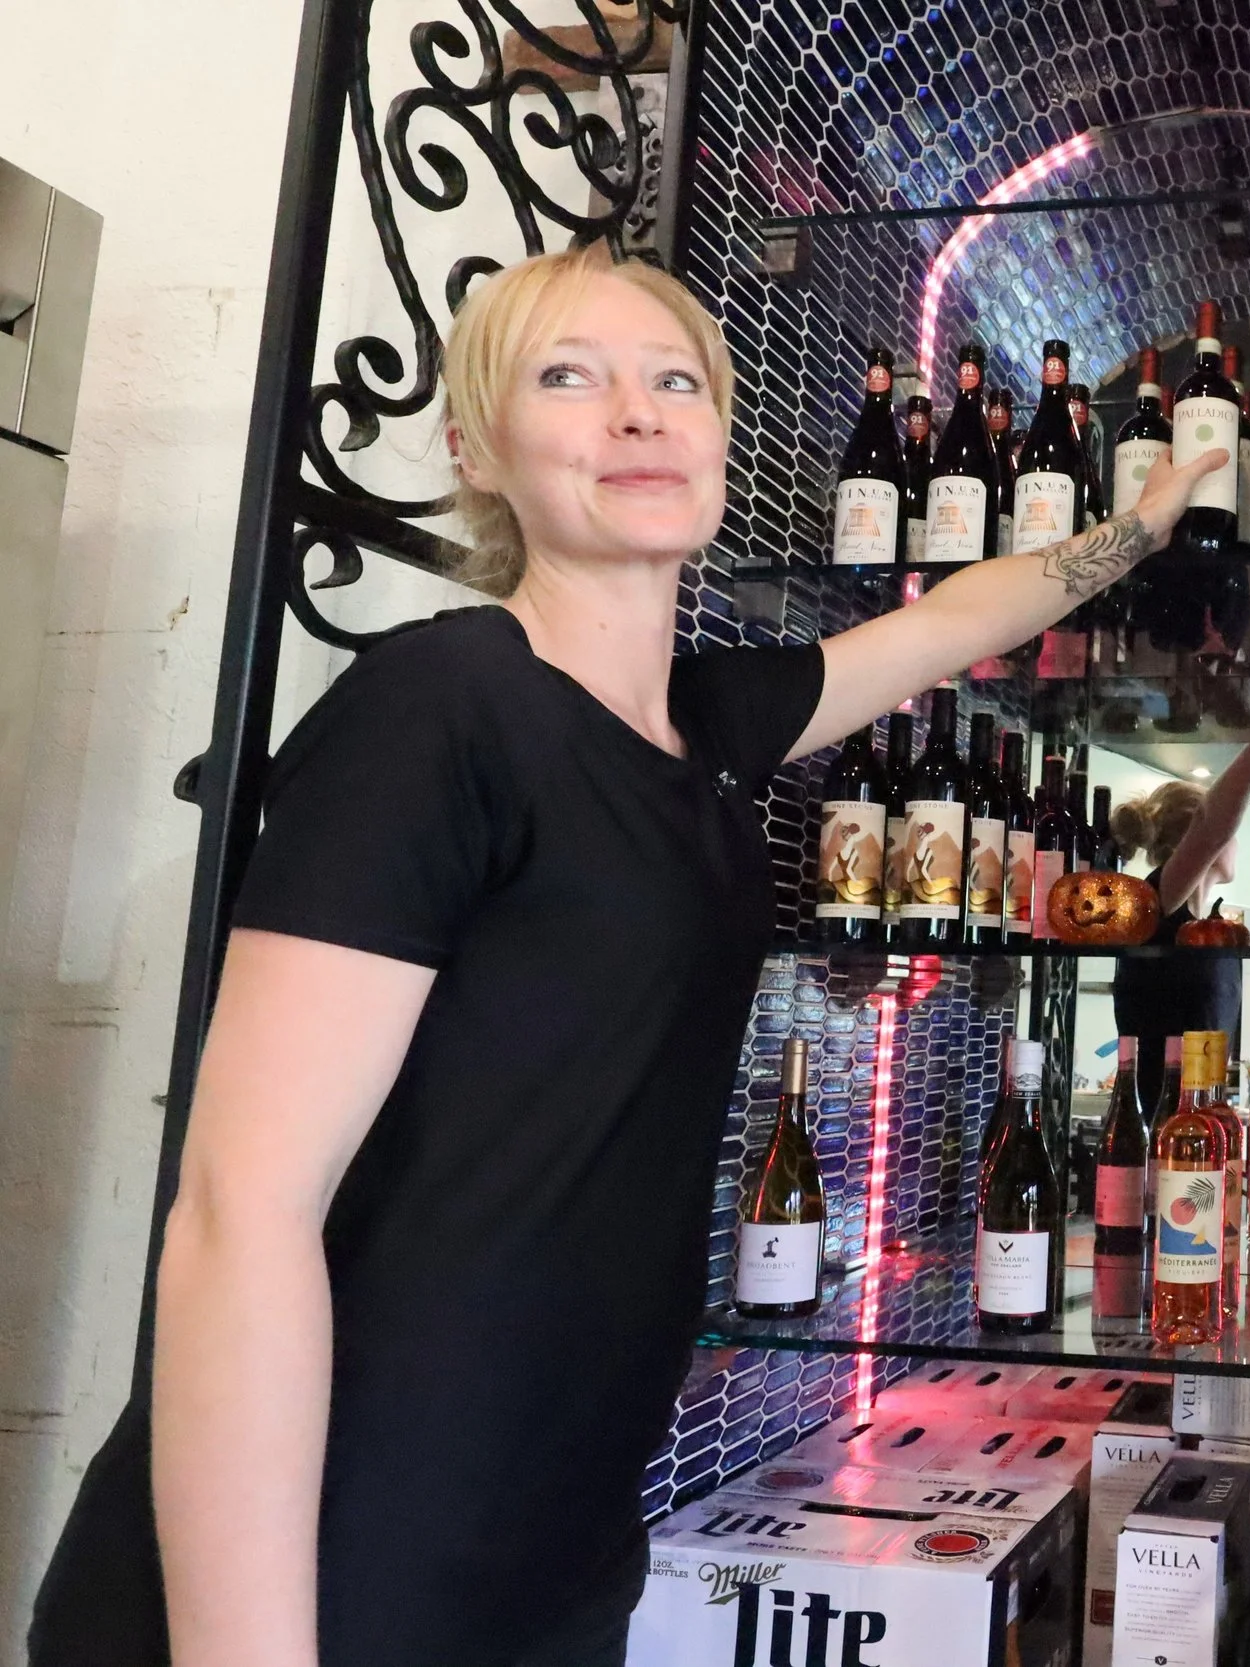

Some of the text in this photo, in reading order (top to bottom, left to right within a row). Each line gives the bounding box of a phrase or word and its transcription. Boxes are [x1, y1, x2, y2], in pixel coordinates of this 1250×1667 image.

[960, 366, 974, 377] 91
[1046, 360, 1060, 371] 91
[870, 368, 884, 379] 91
[910, 414, 923, 425] 91
[990, 409, 1003, 419] 91
[1177, 408, 1234, 422] PALLADIO
[1117, 449, 1160, 462] PALLADI
[838, 487, 892, 499] VINUM
[928, 484, 980, 499] VINUM
[1016, 481, 1069, 495] VINUM
[1105, 1446, 1161, 1464] VELLA
[1205, 1476, 1235, 1504] VELLA
[692, 1509, 808, 1538] Lite
[1132, 1547, 1201, 1570] VELLA
[652, 1568, 689, 1578] BOTTLES
[698, 1561, 787, 1600] Miller
[734, 1582, 888, 1667] Lite
